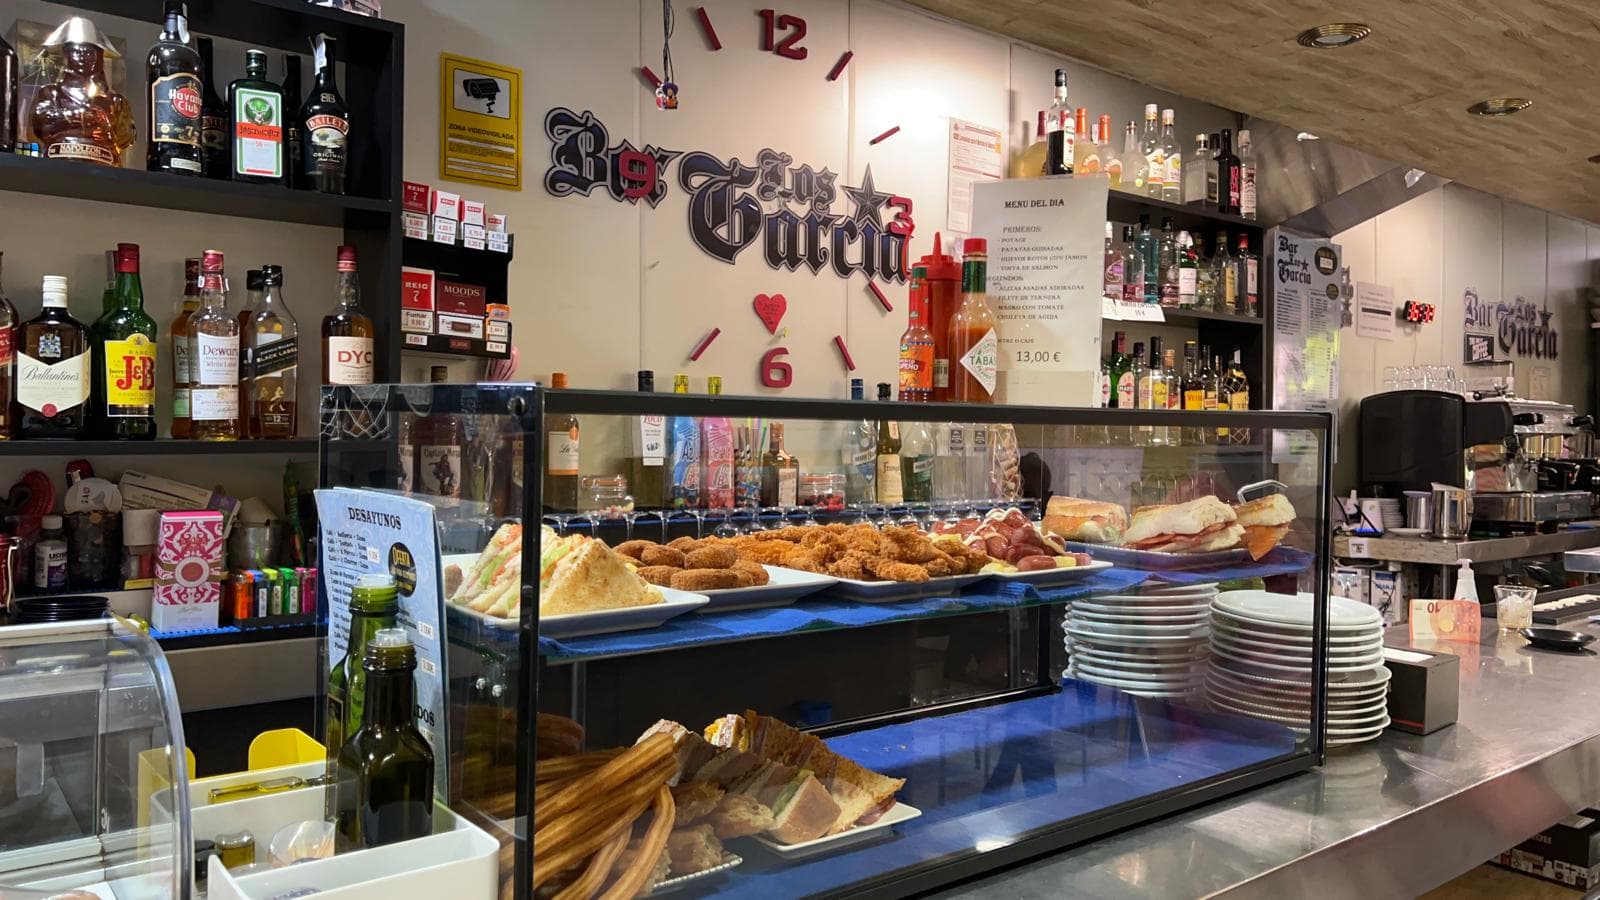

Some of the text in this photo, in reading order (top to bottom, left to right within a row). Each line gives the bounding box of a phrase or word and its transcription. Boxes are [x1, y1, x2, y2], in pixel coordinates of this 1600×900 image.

[760, 9, 808, 60] 12
[177, 101, 199, 114] Club
[308, 115, 348, 132] BAILEYS
[448, 123, 466, 131] ZONA
[467, 127, 514, 140] VIDEOVIGILADA
[620, 151, 656, 198] 9
[758, 148, 839, 213] Los
[1004, 198, 1065, 209] MENU DEL DIA
[1278, 235, 1299, 254] Bar
[405, 282, 429, 290] REIG
[444, 285, 480, 297] MOODS
[338, 350, 373, 364] DYC
[970, 355, 996, 366] TABA
[1016, 351, 1063, 364] 13,00 €
[760, 347, 793, 389] 6
[347, 507, 402, 530] DESAYUNOS
[1427, 602, 1441, 614] 10
